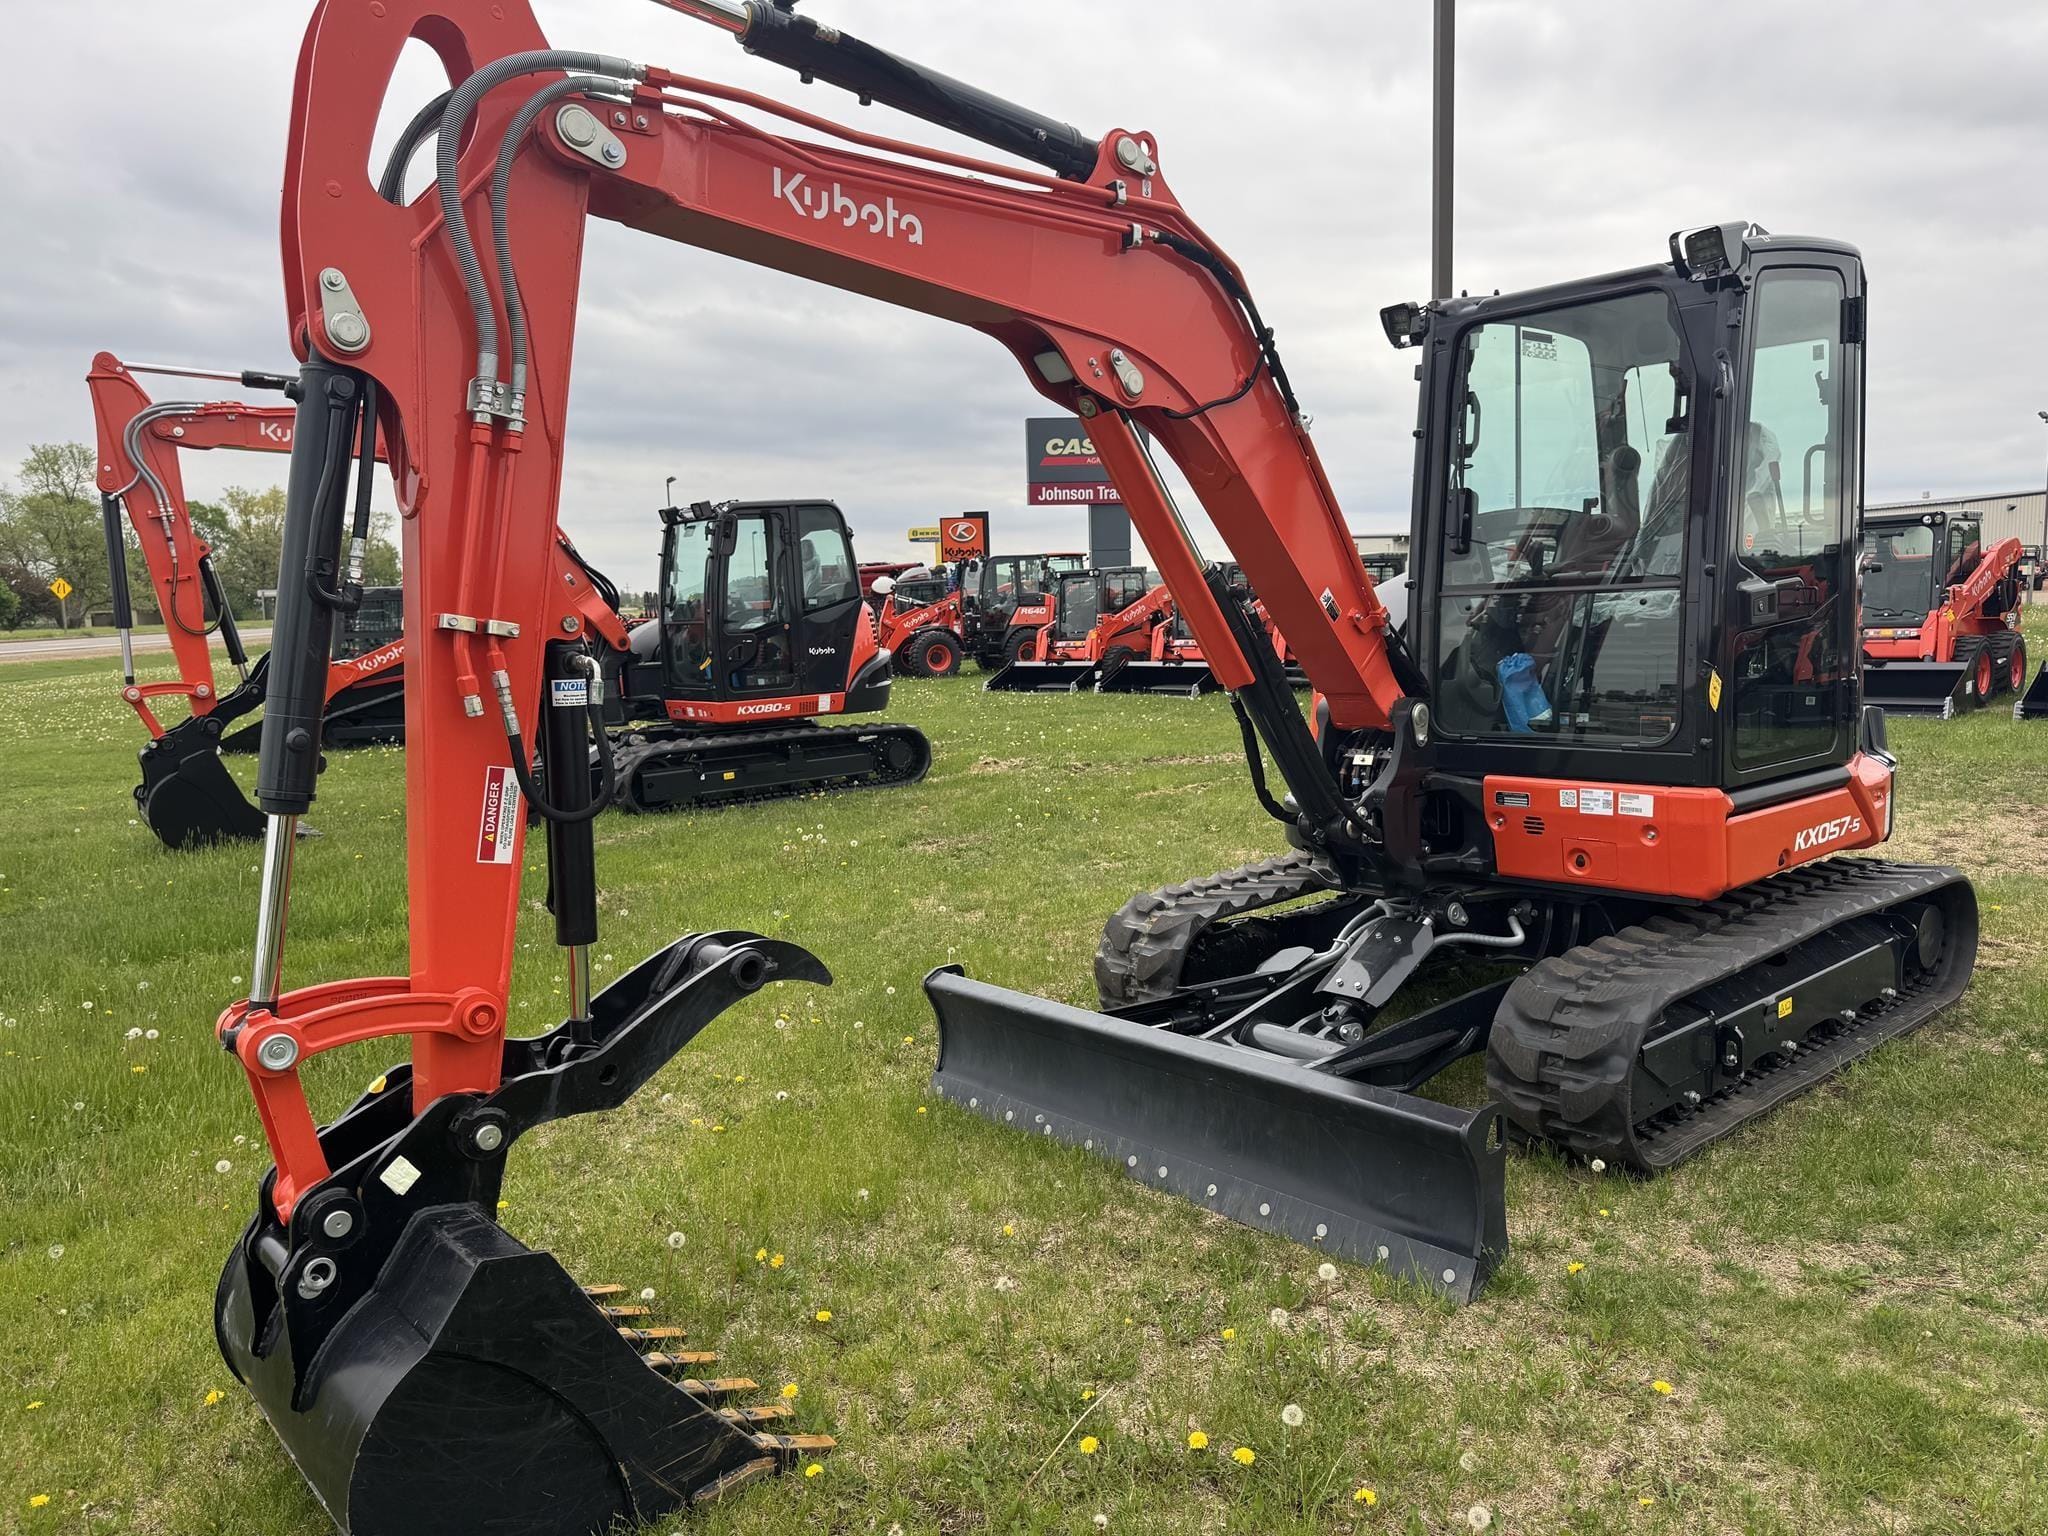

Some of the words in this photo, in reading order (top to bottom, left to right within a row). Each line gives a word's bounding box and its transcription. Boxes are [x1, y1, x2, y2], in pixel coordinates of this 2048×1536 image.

[773, 166, 923, 246] Kubota
[1038, 486, 1094, 501] Johnson
[944, 547, 982, 557] Kubota
[1971, 570, 1992, 597] Kubota
[903, 612, 930, 629] Kubota
[1122, 604, 1146, 623] Kubota
[808, 646, 836, 655] Kubota
[737, 703, 792, 716] KX080-5
[486, 782, 500, 831] DANGER
[1794, 816, 1861, 852] KX057-5
